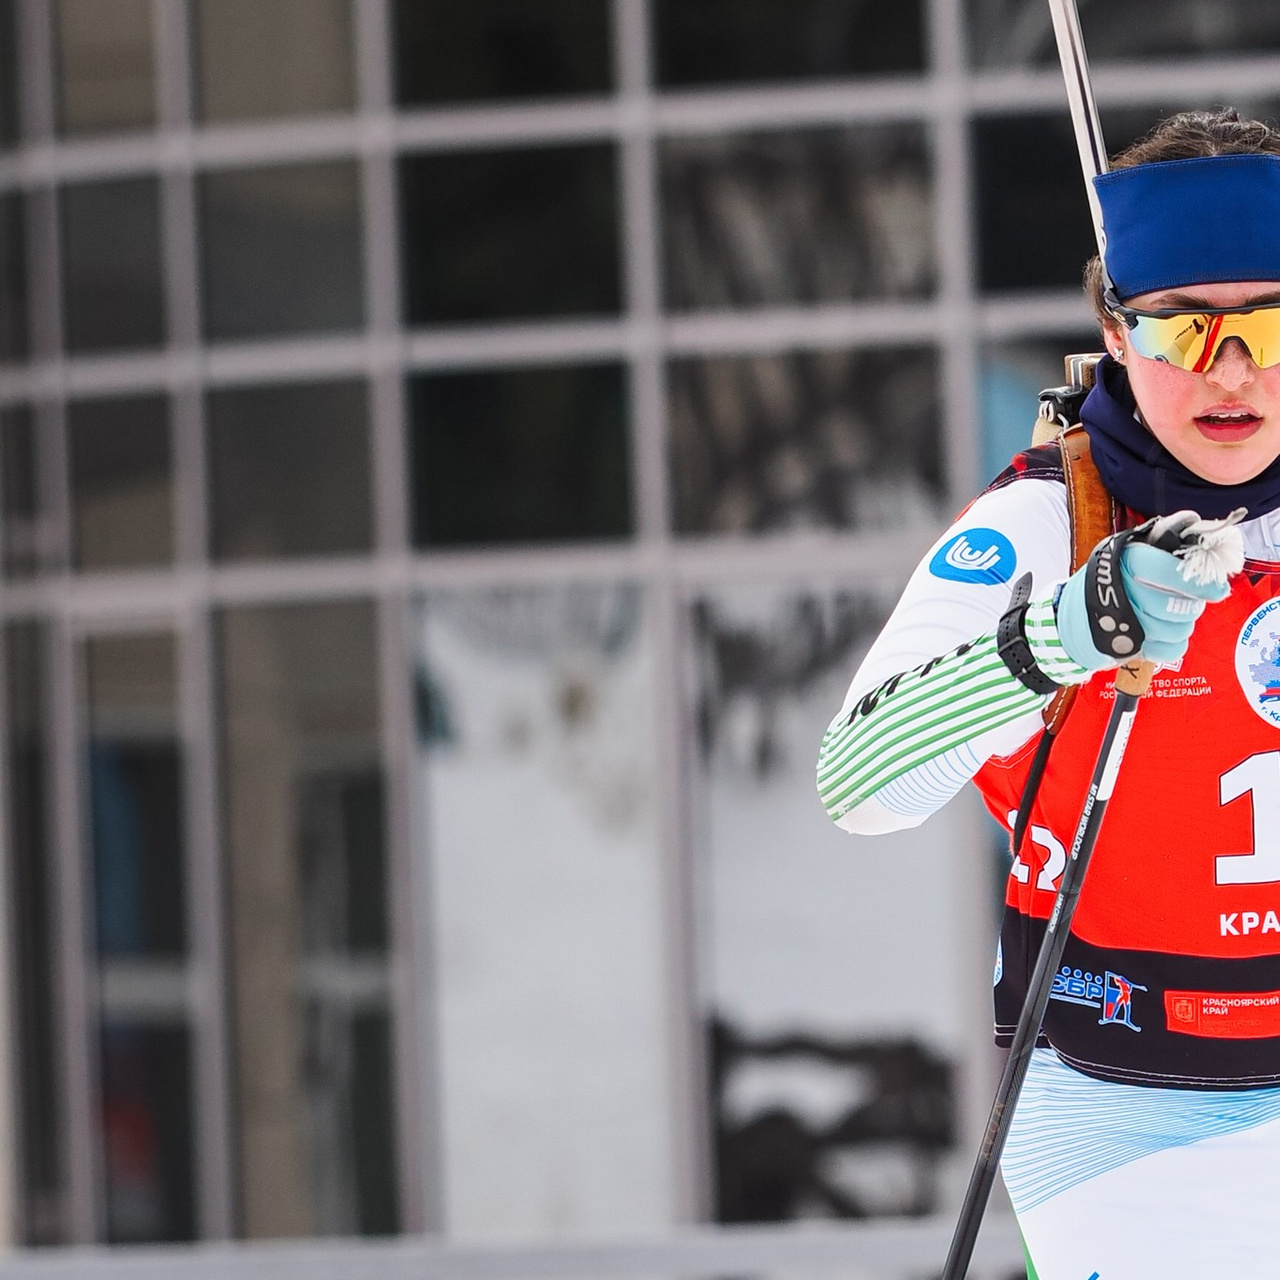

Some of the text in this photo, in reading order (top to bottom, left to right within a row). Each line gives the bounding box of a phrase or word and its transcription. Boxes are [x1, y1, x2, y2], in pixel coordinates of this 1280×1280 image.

[1172, 676, 1208, 688] СПОРТА
[1155, 687, 1213, 699] ФЕДЕРАЦИИ
[1083, 795, 1096, 817] STAR
[1202, 996, 1280, 1008] КРАСНОЯРСКИЙ
[1202, 1006, 1228, 1016] КРАЙ
